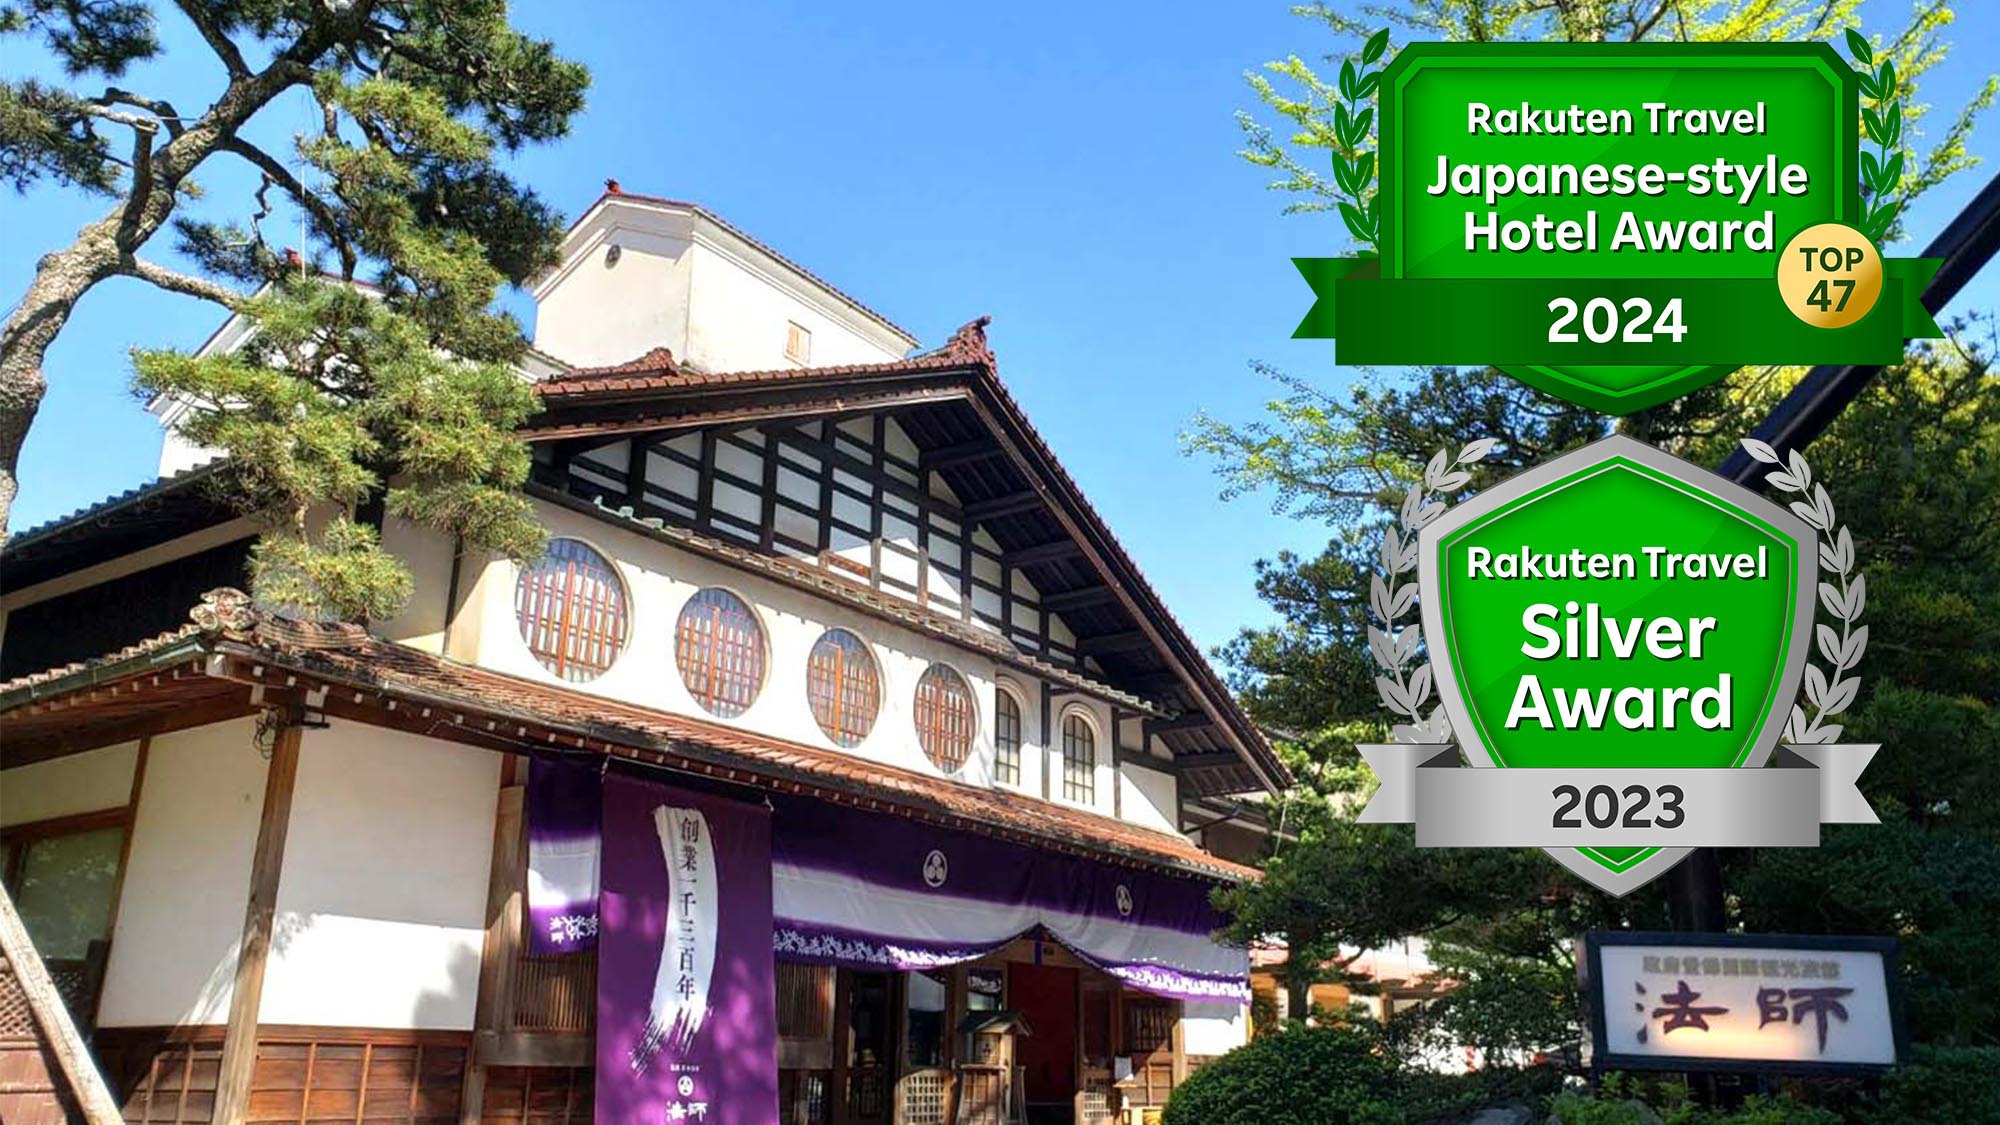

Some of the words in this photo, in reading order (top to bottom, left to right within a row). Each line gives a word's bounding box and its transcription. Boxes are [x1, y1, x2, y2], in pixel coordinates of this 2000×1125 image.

[676, 816, 700, 1001] 創業一千三百年
[1635, 980, 1853, 1054] 法師
